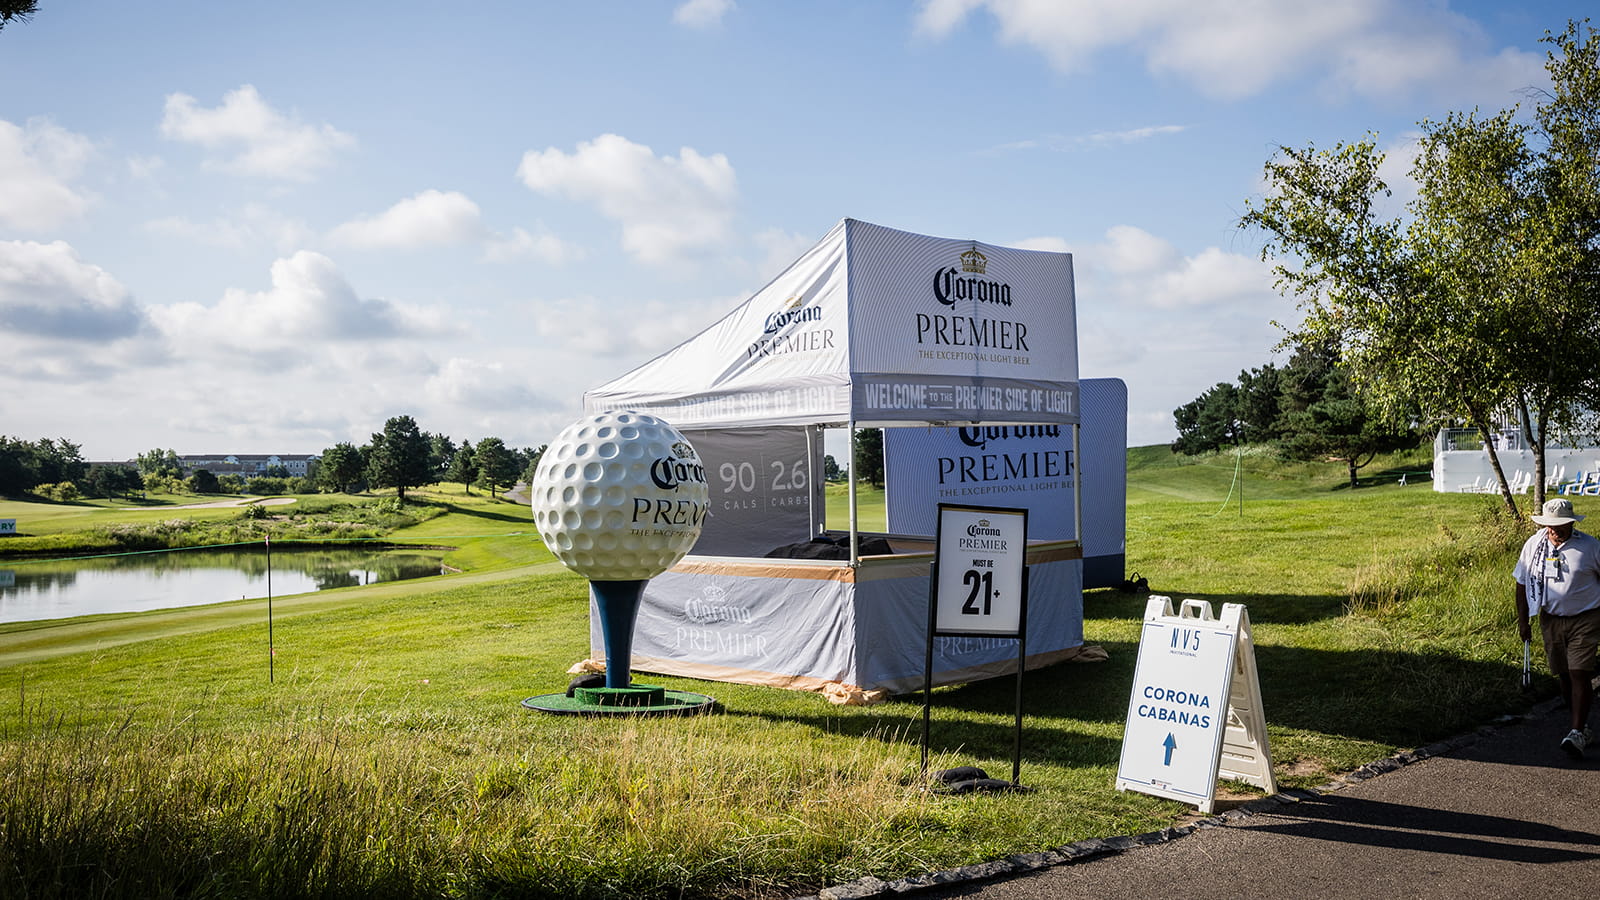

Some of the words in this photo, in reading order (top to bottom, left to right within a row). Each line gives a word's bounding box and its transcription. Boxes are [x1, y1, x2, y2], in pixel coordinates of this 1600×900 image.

[933, 266, 1013, 311] Corona
[764, 305, 822, 335] Corona
[916, 313, 1030, 352] PREMIER
[747, 328, 835, 358] PREMIER
[918, 351, 934, 359] THE
[936, 351, 988, 362] EXCEPTIONAL
[990, 354, 1011, 364] LIGHT
[1013, 356, 1031, 365] BEER
[740, 389, 769, 416] SIDE
[773, 388, 792, 415] OF
[800, 385, 836, 413] LIGHT
[865, 384, 927, 409] WELCOME
[929, 392, 938, 402] TO
[940, 392, 953, 402] THE
[955, 385, 1003, 411] PREMIER
[1005, 388, 1028, 412] SIDE
[1031, 390, 1043, 412] OF
[1046, 391, 1073, 413] LIGHT
[719, 462, 756, 493] 90
[771, 460, 807, 491] 2.6
[937, 450, 1082, 485] PREMIER
[771, 495, 809, 507] CARBS
[939, 488, 959, 498] THE
[961, 484, 1028, 496] EXCEPTIONAL
[1030, 481, 1058, 491] LIGHT
[1061, 479, 1082, 489] BE
[632, 497, 708, 527] PREM
[723, 499, 757, 511] CALS
[959, 538, 1008, 551] PREMIER
[967, 524, 1001, 538] Corona
[972, 559, 986, 568] MUST
[987, 559, 994, 568] BE
[684, 598, 752, 625] Corona
[676, 627, 769, 659] PREMIER
[1143, 686, 1210, 709] CORONA
[1138, 704, 1211, 729] CABANAS
